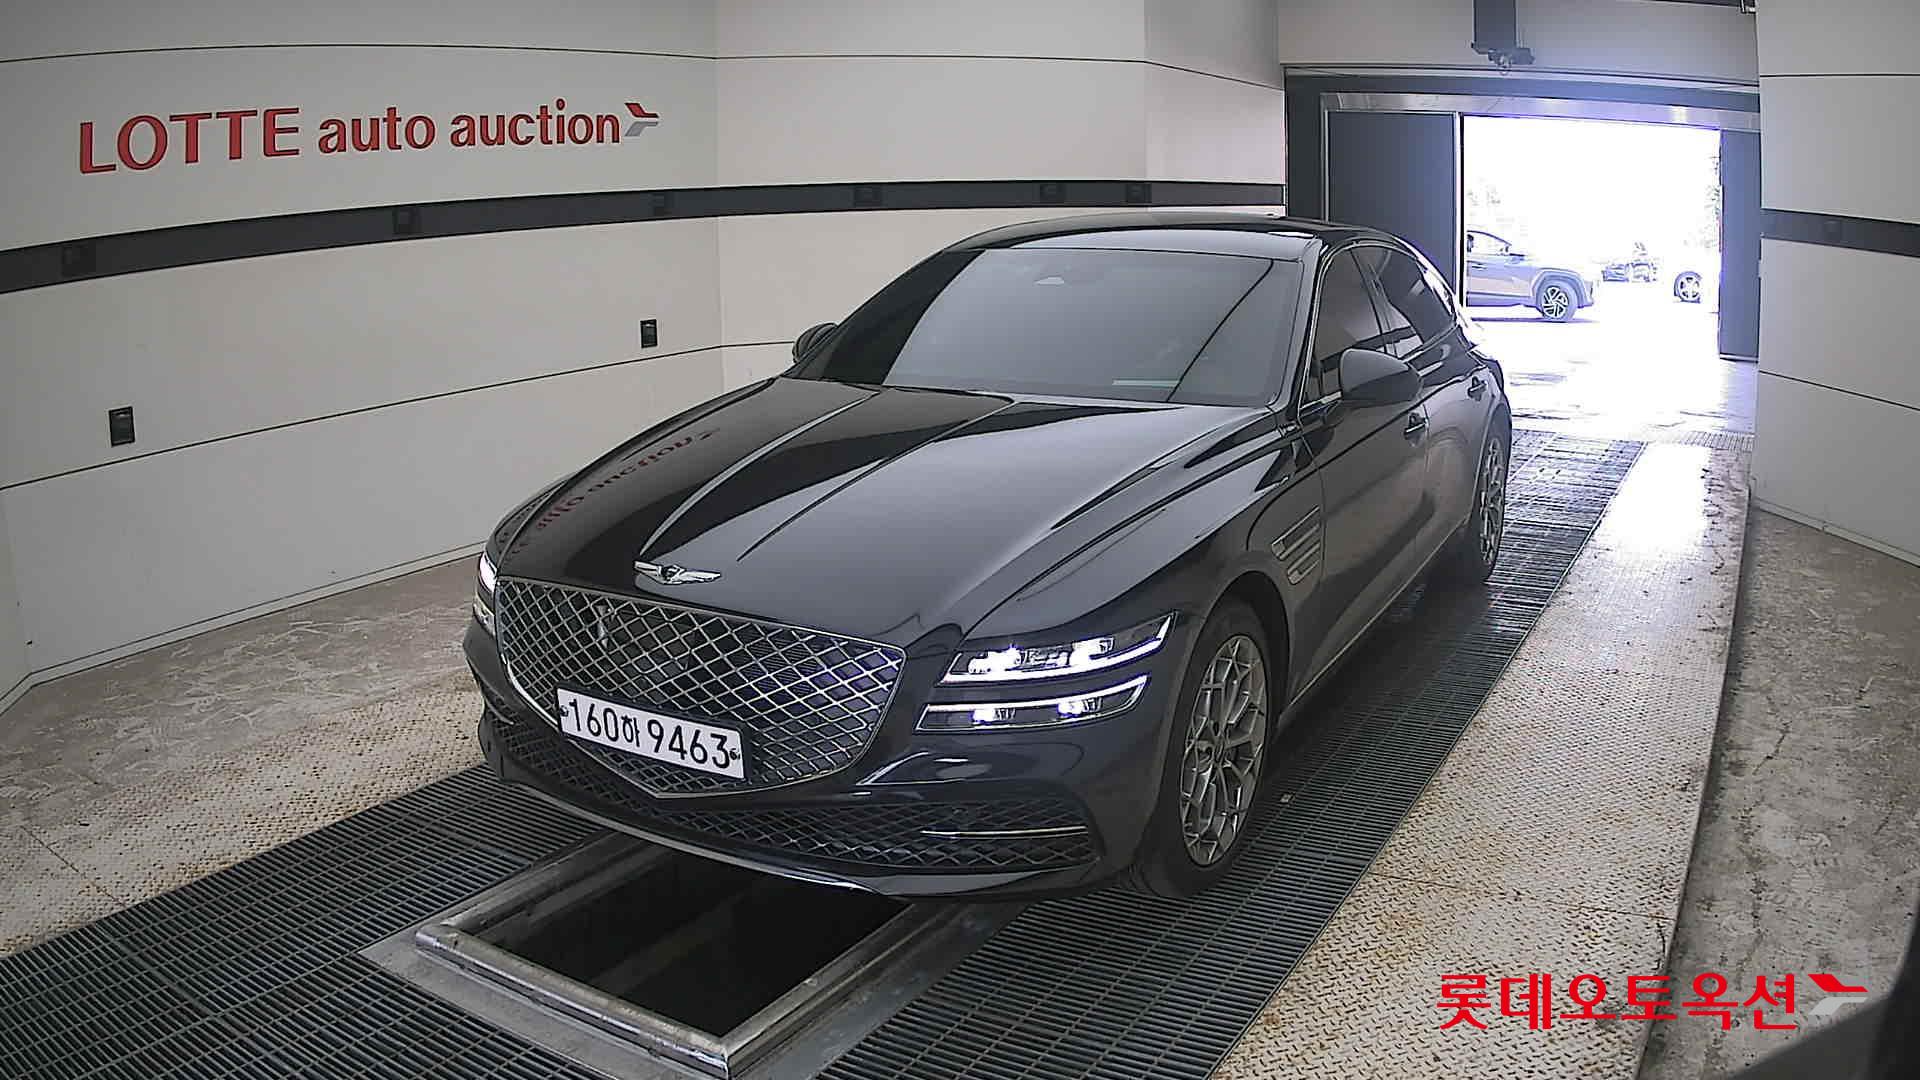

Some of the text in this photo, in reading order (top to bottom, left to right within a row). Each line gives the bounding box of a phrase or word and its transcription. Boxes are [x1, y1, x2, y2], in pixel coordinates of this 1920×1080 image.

[79, 98, 622, 174] LOTTE auto auction
[568, 698, 731, 770] 160하 9463
